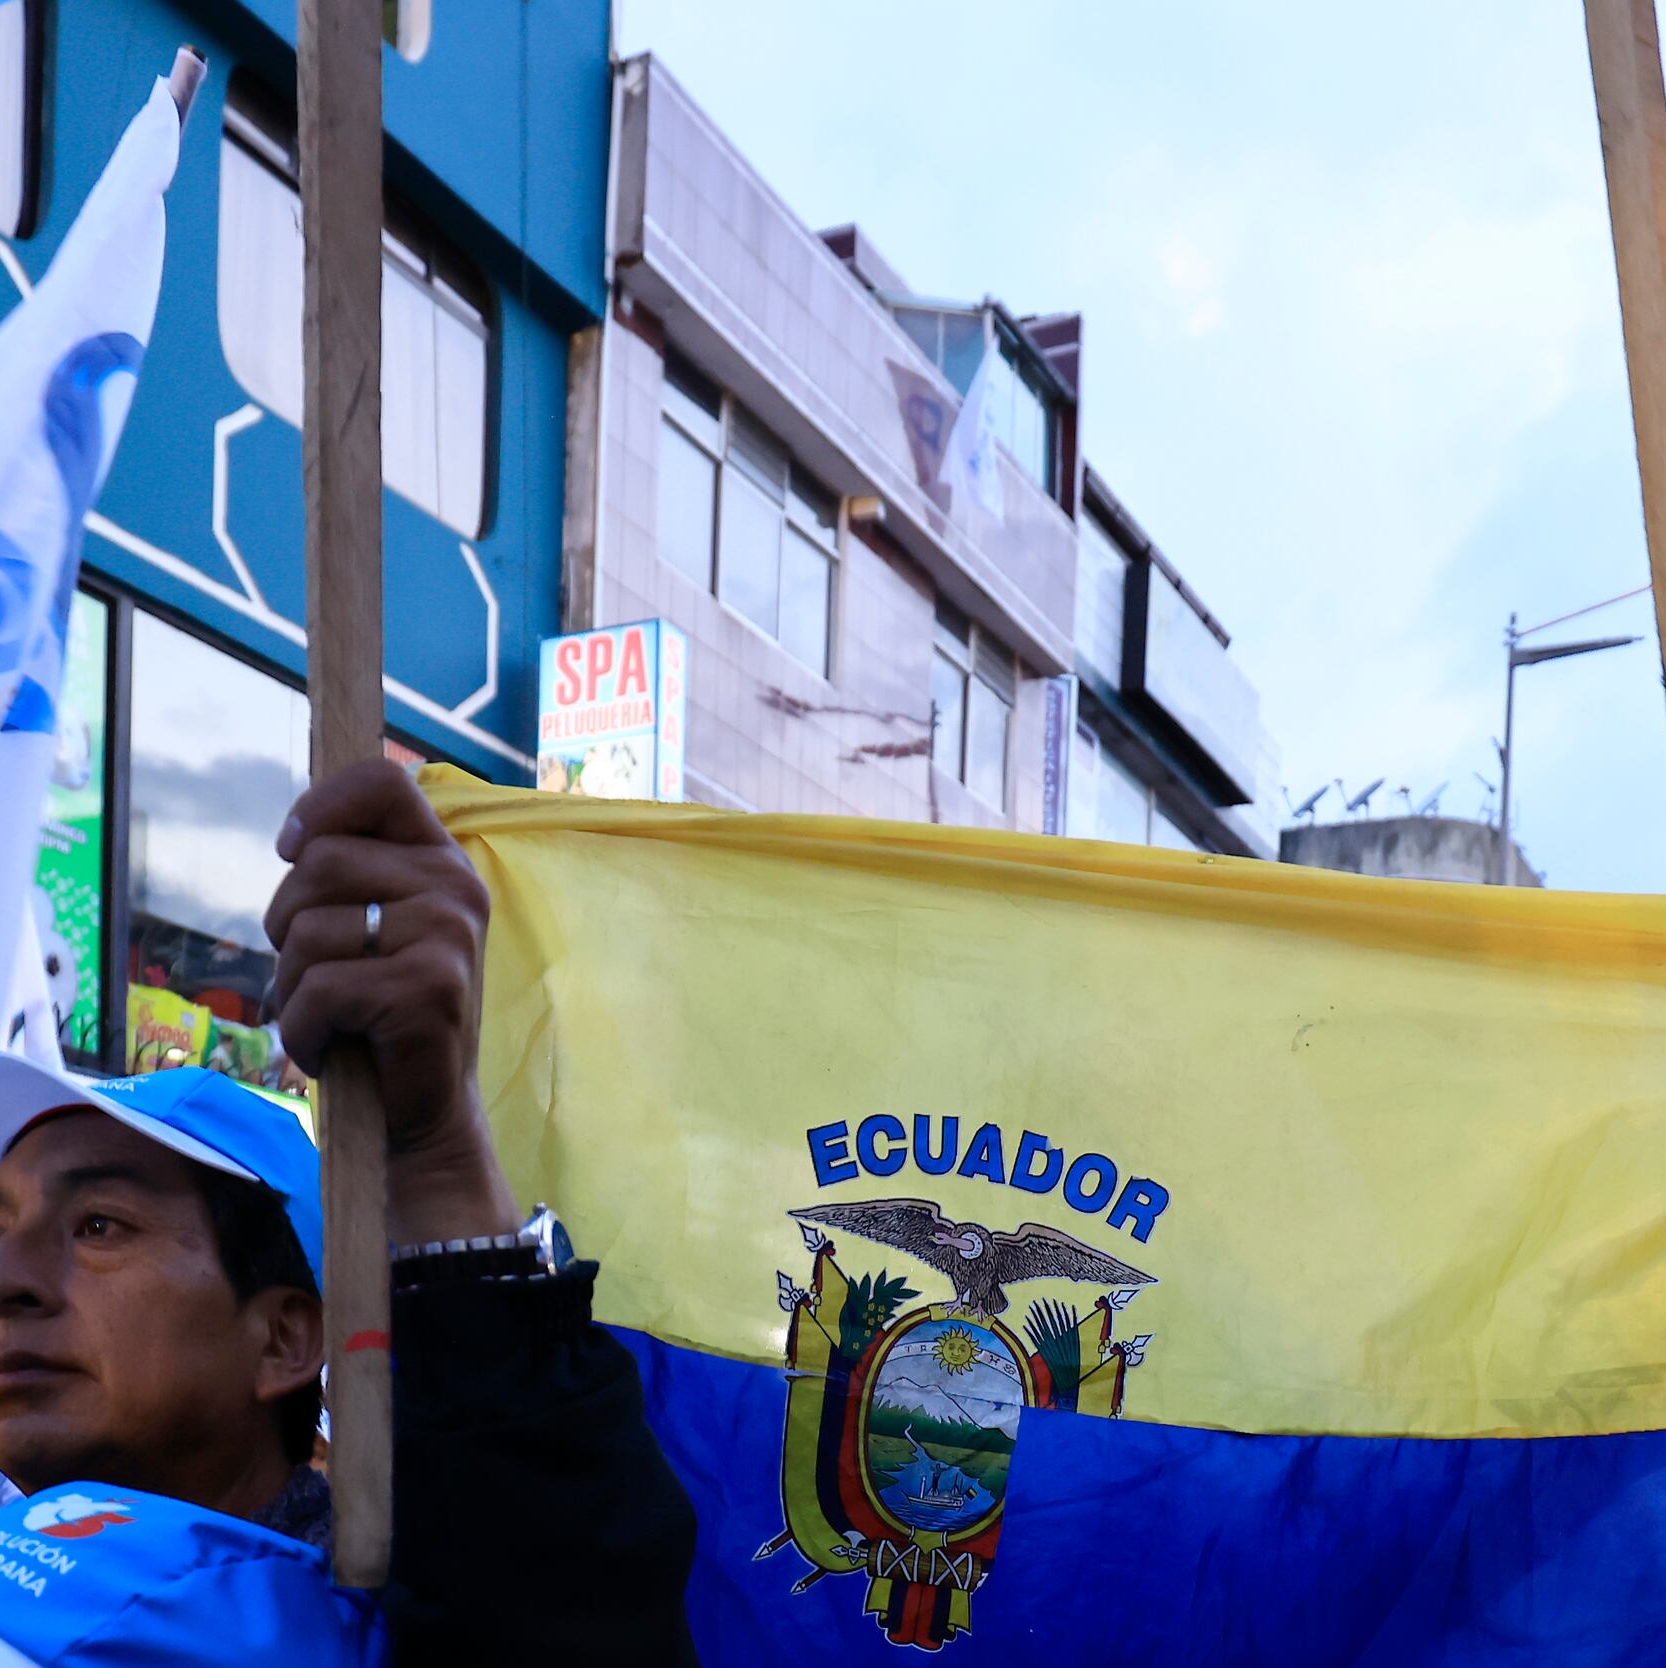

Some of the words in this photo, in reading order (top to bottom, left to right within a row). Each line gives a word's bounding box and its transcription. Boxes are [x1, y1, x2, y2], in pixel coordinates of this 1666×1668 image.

[555, 627, 648, 706] SPA
[540, 697, 655, 742] PELUQUERIA
[806, 1112, 1171, 1244] ECUADOR
